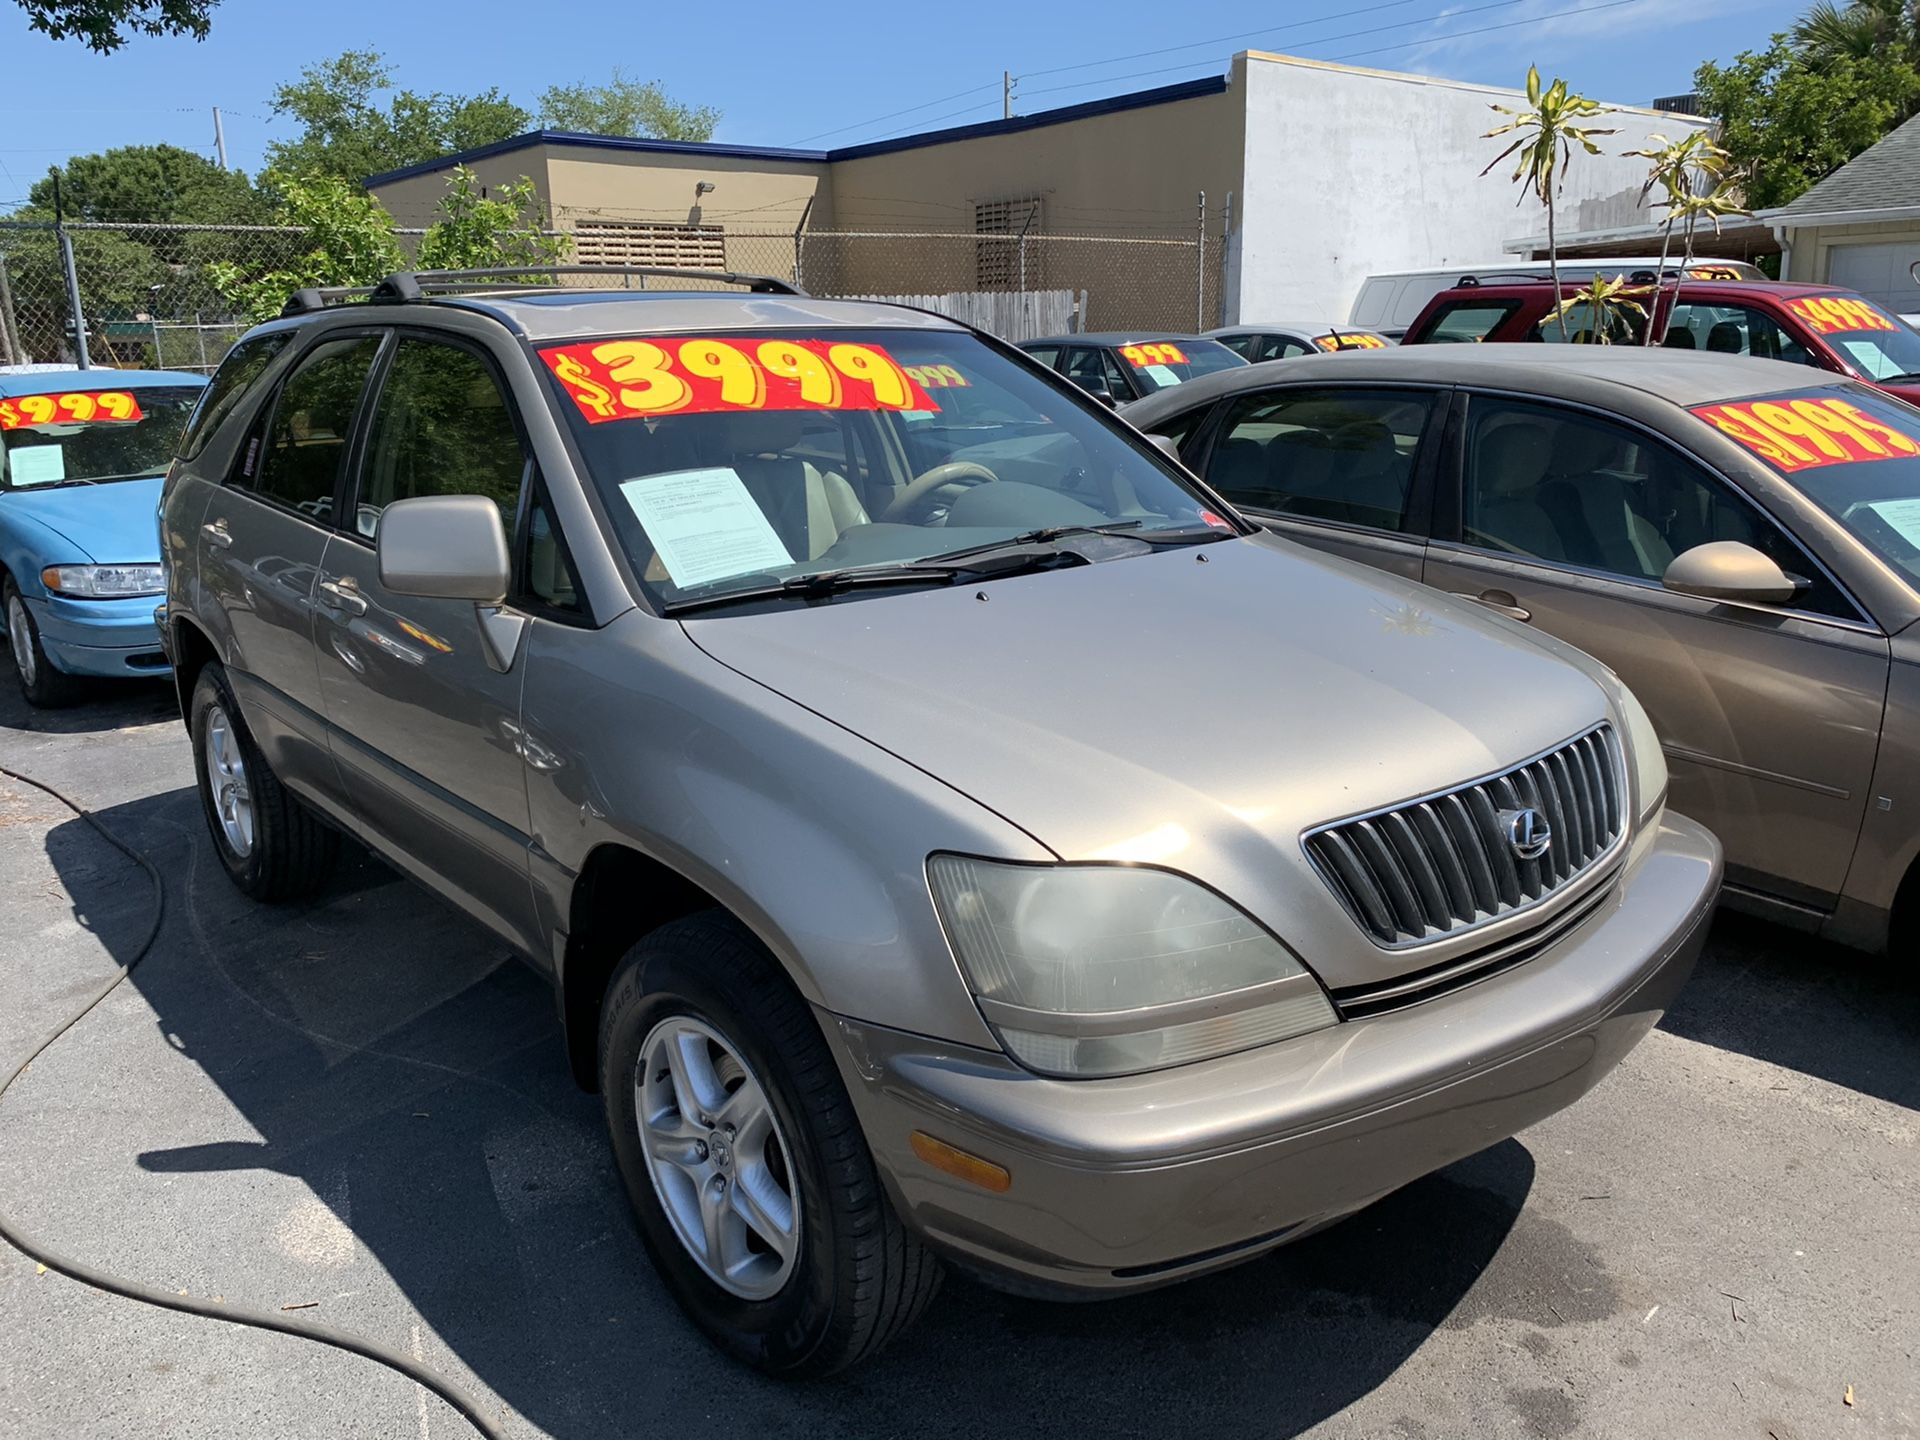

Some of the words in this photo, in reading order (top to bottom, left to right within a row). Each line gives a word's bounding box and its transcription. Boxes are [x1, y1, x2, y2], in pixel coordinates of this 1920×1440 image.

[1790, 298, 1894, 332] $4995
[1123, 343, 1185, 366] 999
[555, 339, 914, 416] $3999
[0, 393, 135, 428] $999
[1704, 399, 1920, 467] $1995
